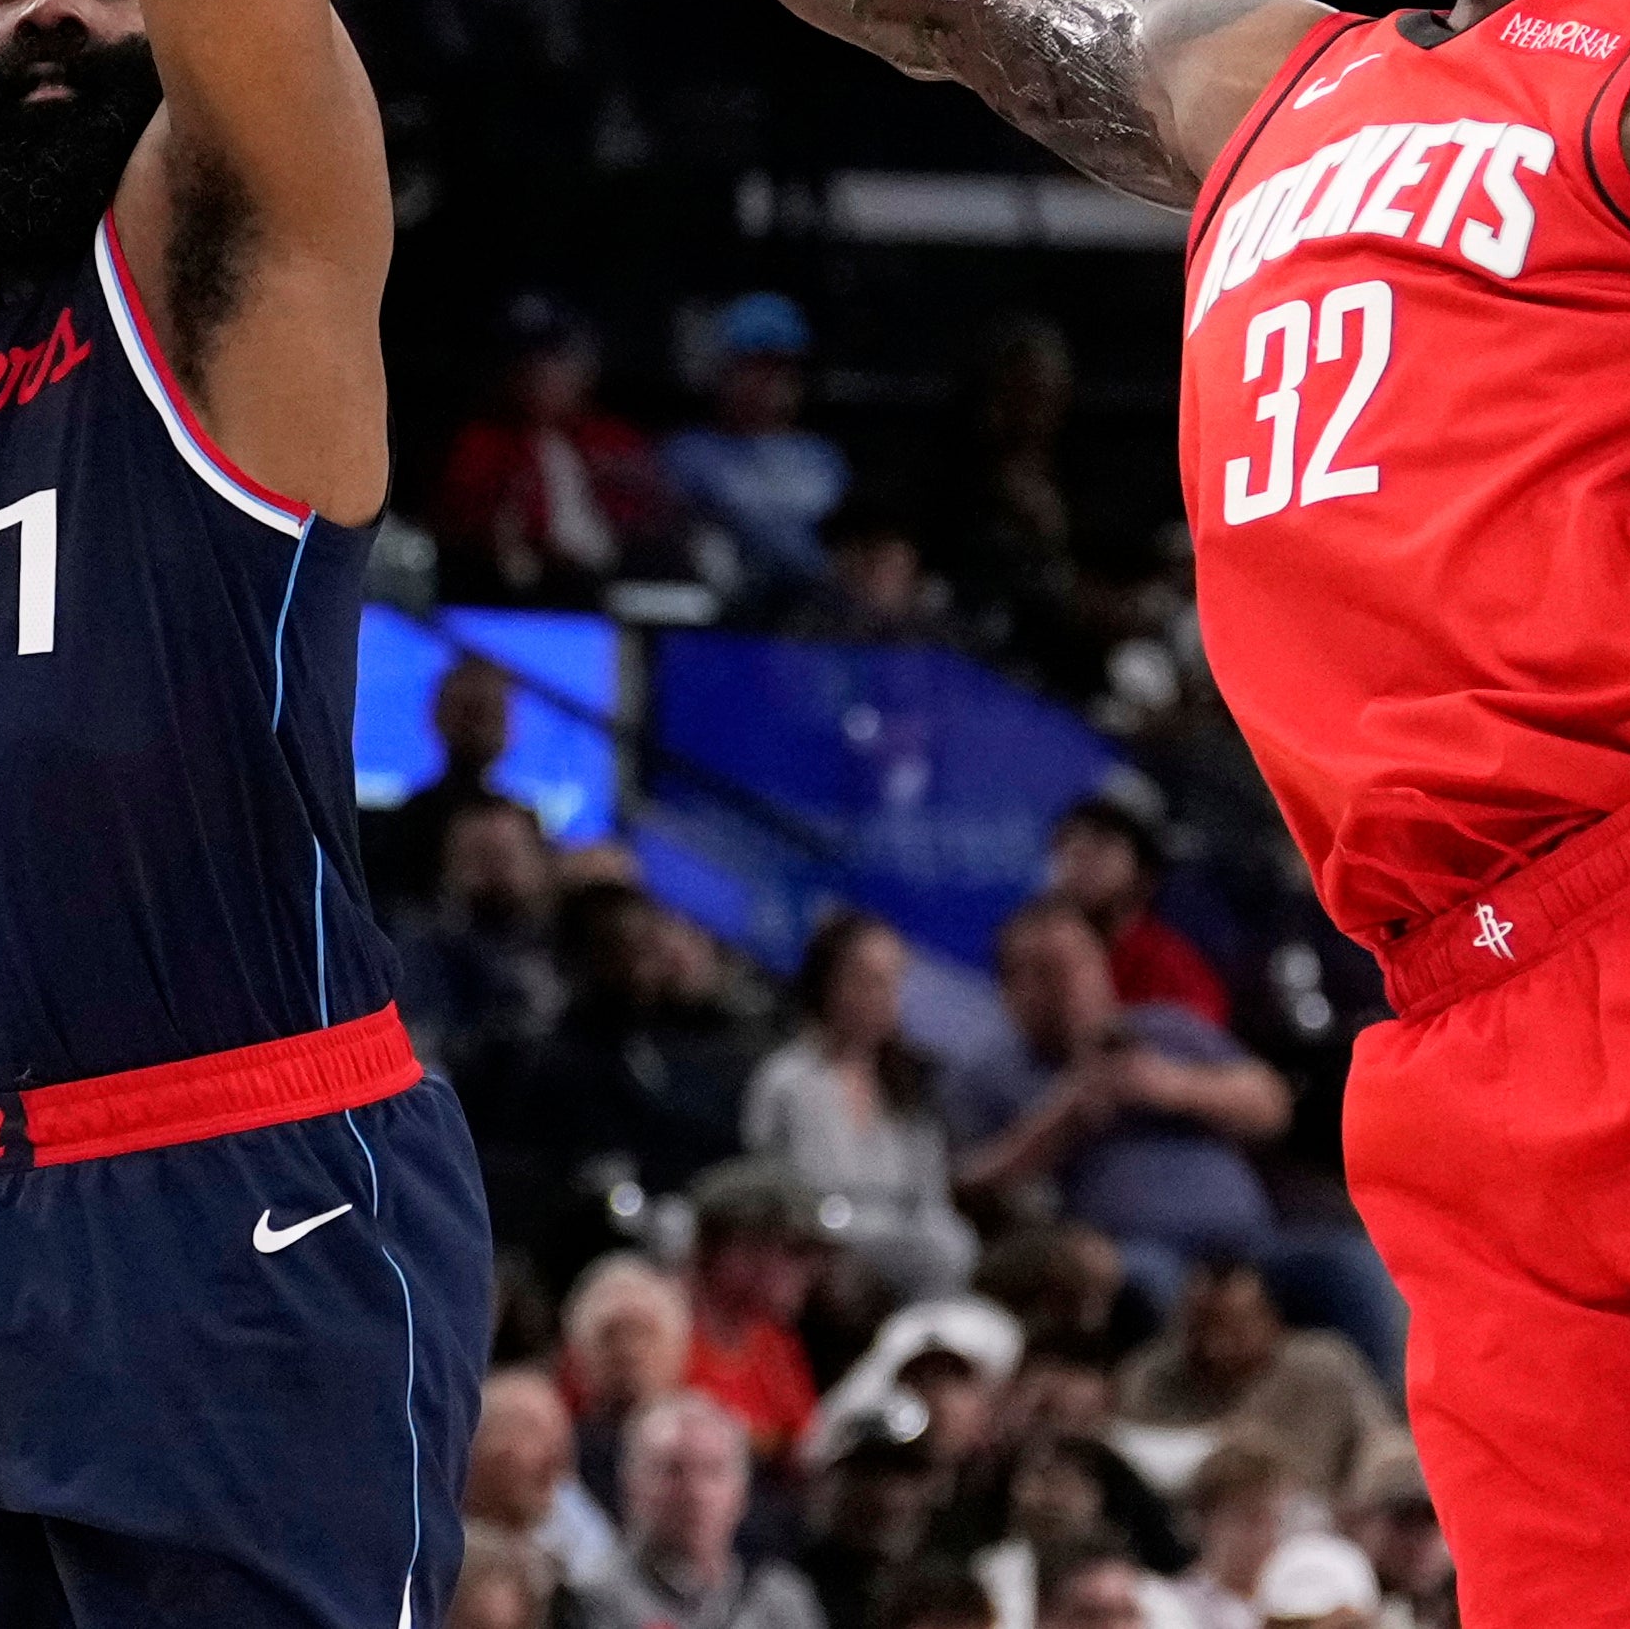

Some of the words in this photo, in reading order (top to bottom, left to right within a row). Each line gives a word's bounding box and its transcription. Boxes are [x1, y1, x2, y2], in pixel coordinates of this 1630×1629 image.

[1499, 27, 1616, 60] HERMANN
[1507, 12, 1621, 51] MEMORIAL
[1187, 118, 1556, 340] ROCKETS
[1223, 279, 1393, 526] 32
